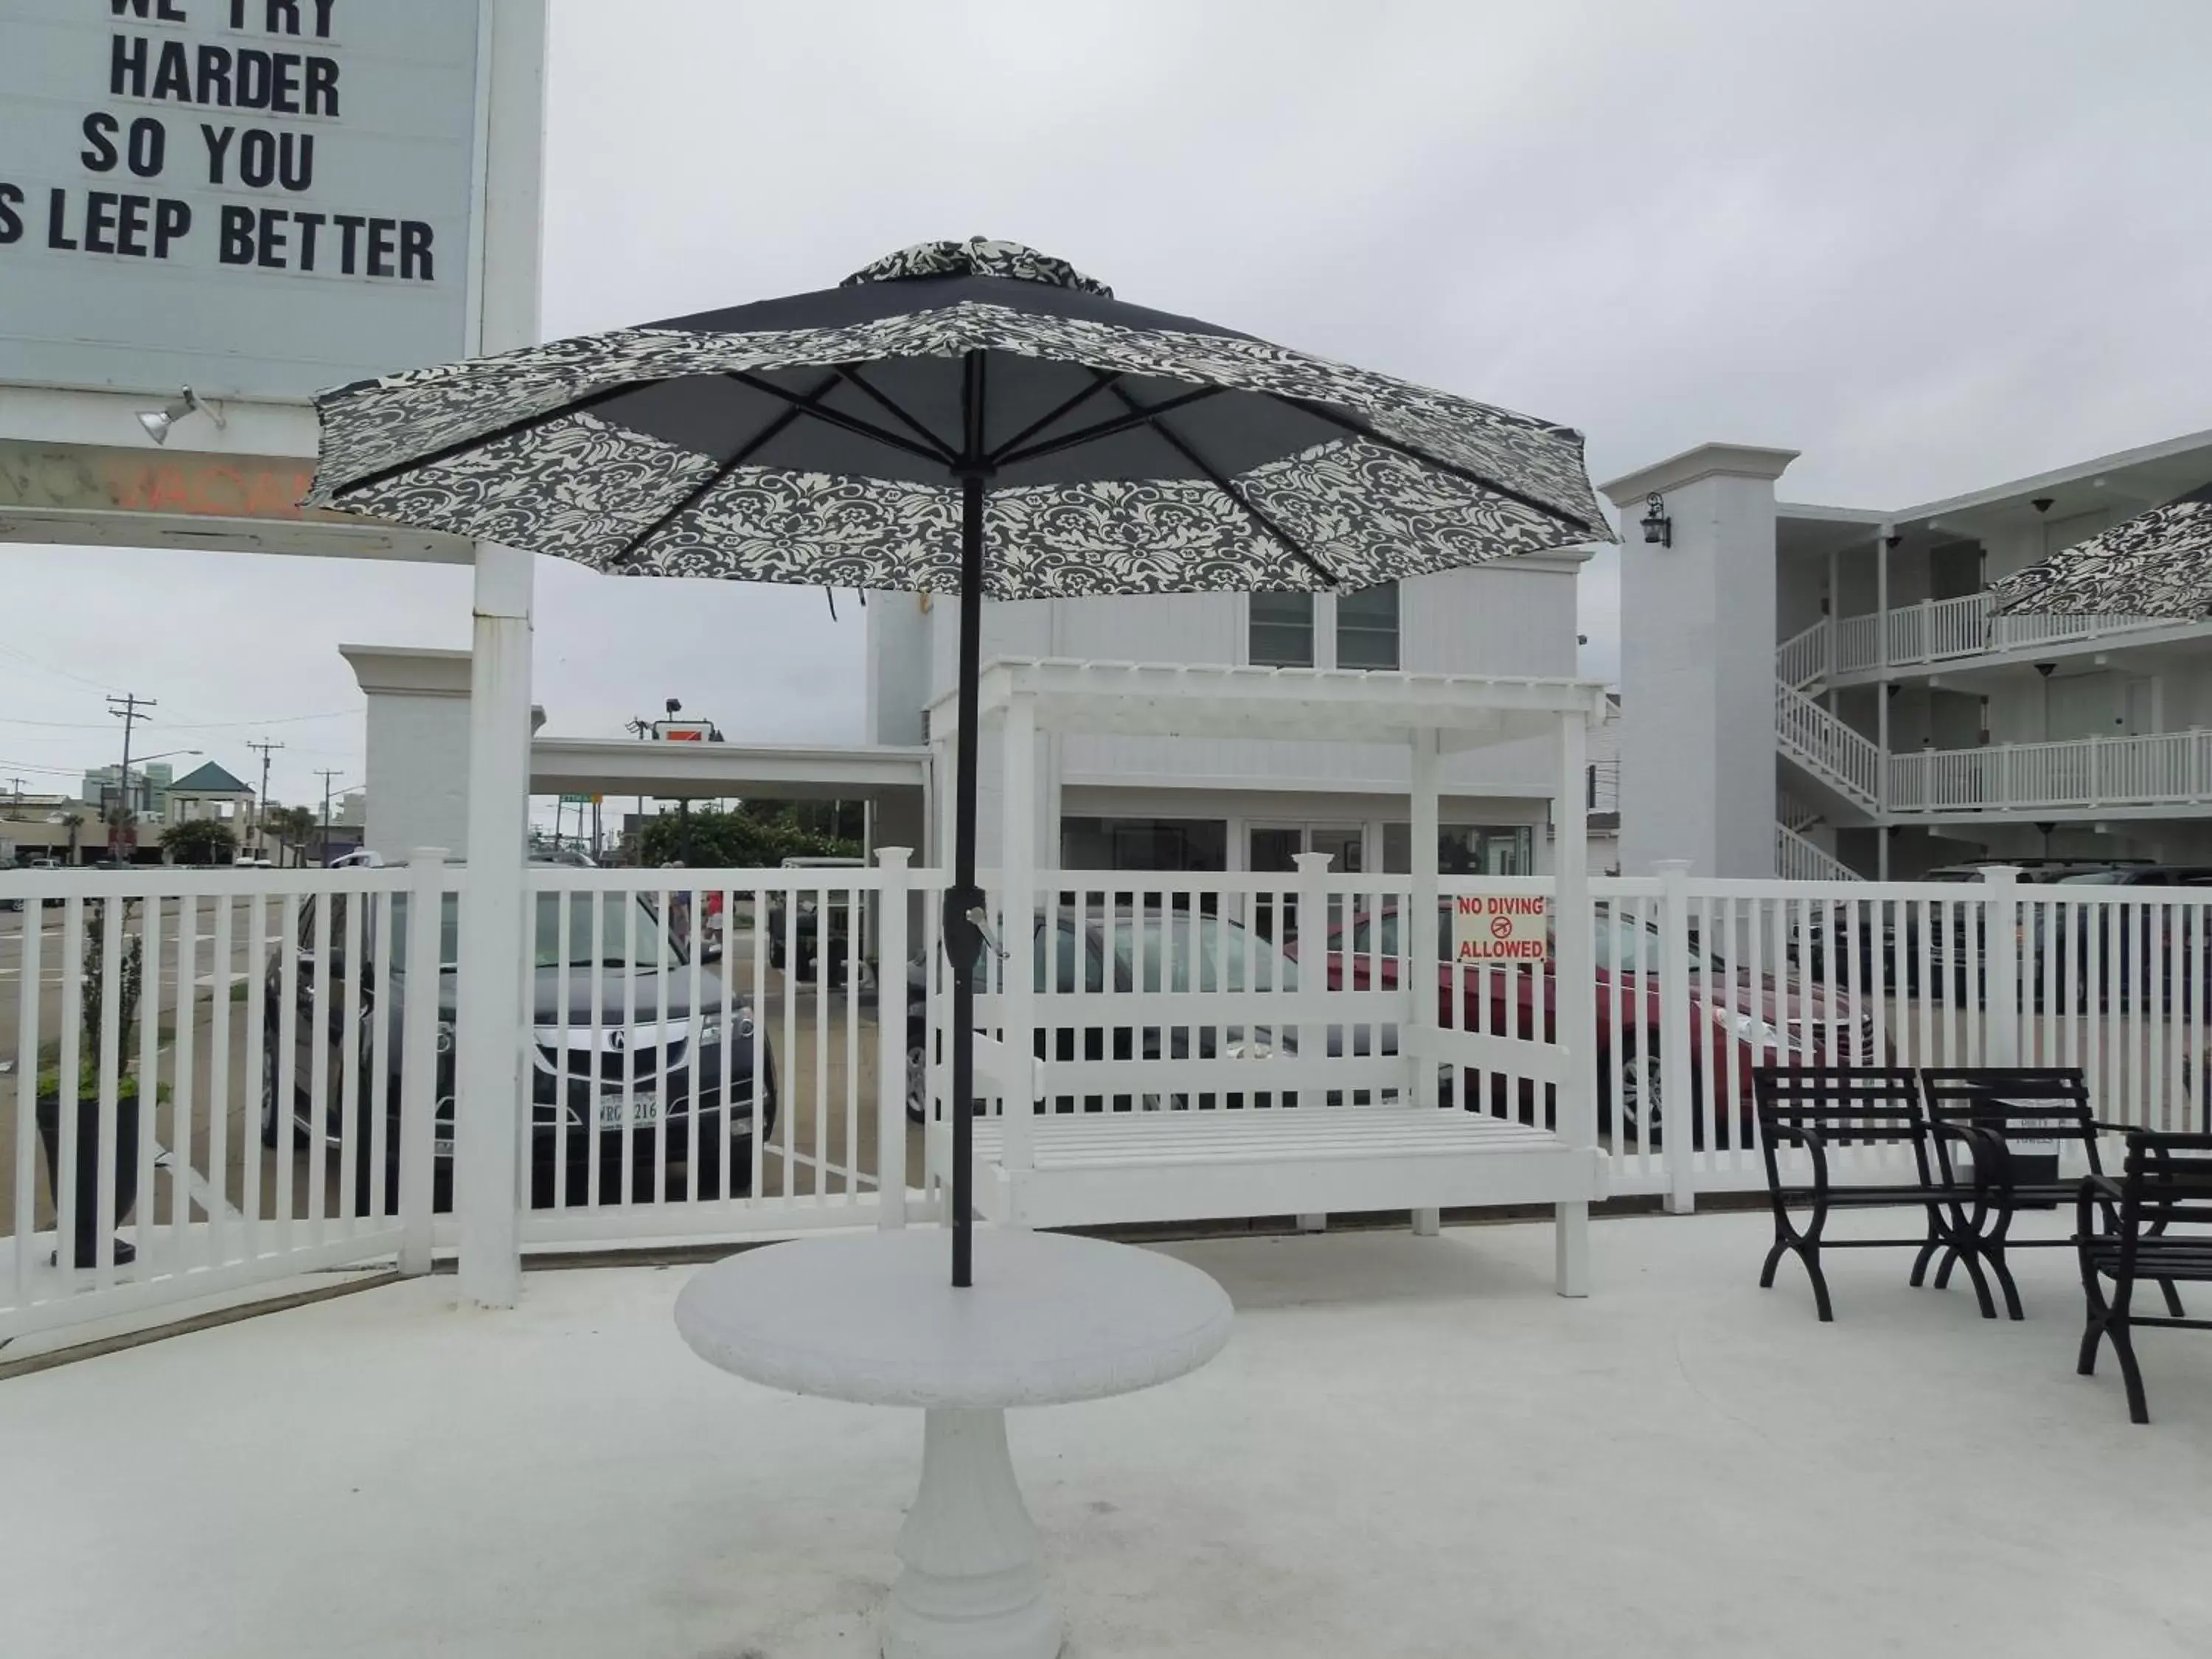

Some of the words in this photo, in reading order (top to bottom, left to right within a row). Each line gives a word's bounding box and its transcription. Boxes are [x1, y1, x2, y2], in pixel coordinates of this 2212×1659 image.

[111, 35, 340, 116] HARDER
[81, 112, 166, 177] SO
[201, 124, 313, 191] YOU
[219, 204, 434, 280] BETTER
[1459, 897, 1482, 915] NO
[1488, 897, 1543, 915] DIVING
[1460, 940, 1543, 958] ALLOWED
